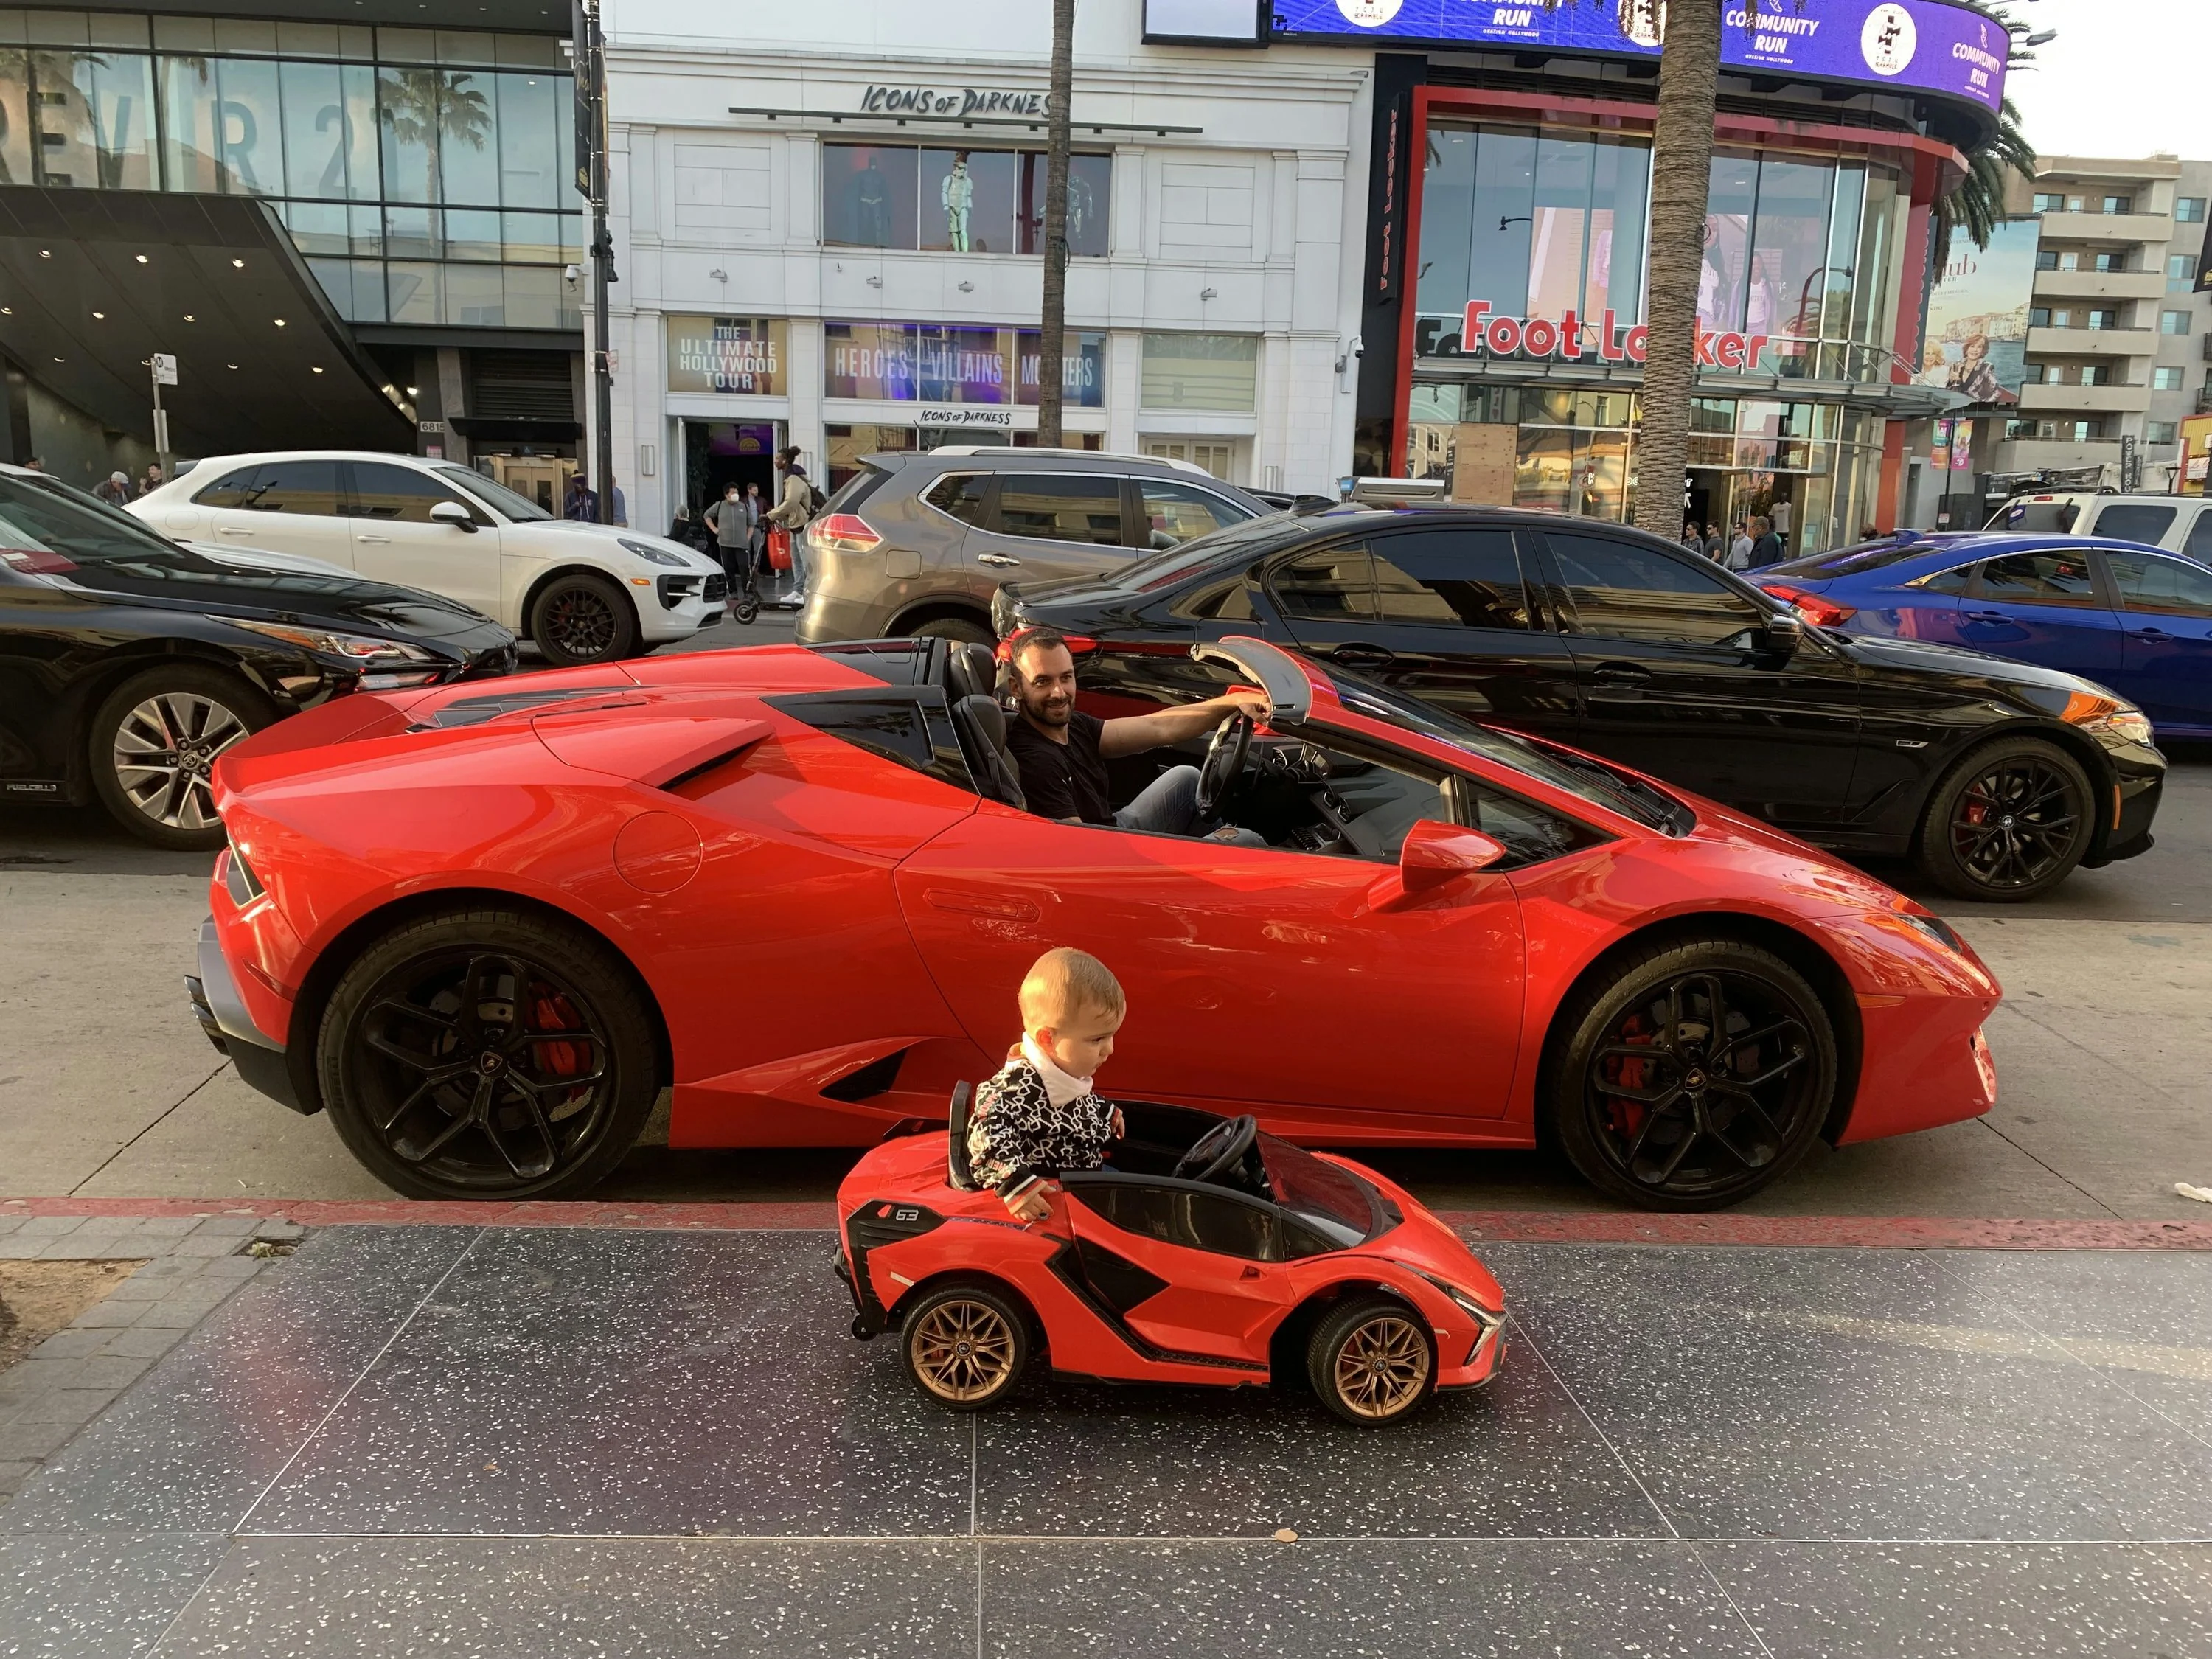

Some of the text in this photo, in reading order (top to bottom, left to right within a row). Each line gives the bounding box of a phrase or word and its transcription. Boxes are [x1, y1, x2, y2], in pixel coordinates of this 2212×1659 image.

[1492, 8, 1531, 27] RUN
[1754, 35, 1788, 54] RUN
[1952, 42, 2001, 75] COMMUNITY
[1969, 68, 1989, 88] RUN
[860, 85, 1051, 119] ICONS OF DARKNES
[716, 327, 740, 340] THE
[1460, 299, 1583, 359] Foot
[1601, 307, 1770, 370] Loker
[681, 338, 776, 357] ULTIMATE
[679, 355, 778, 373] HOLLYWOOD
[835, 347, 1093, 387] HEROES VILLAINS MOTERS
[704, 372, 753, 389] TOUR
[422, 422, 445, 431] 6815
[920, 410, 1012, 425] ICONS OF DARKNESS
[896, 1209, 919, 1221] 63
